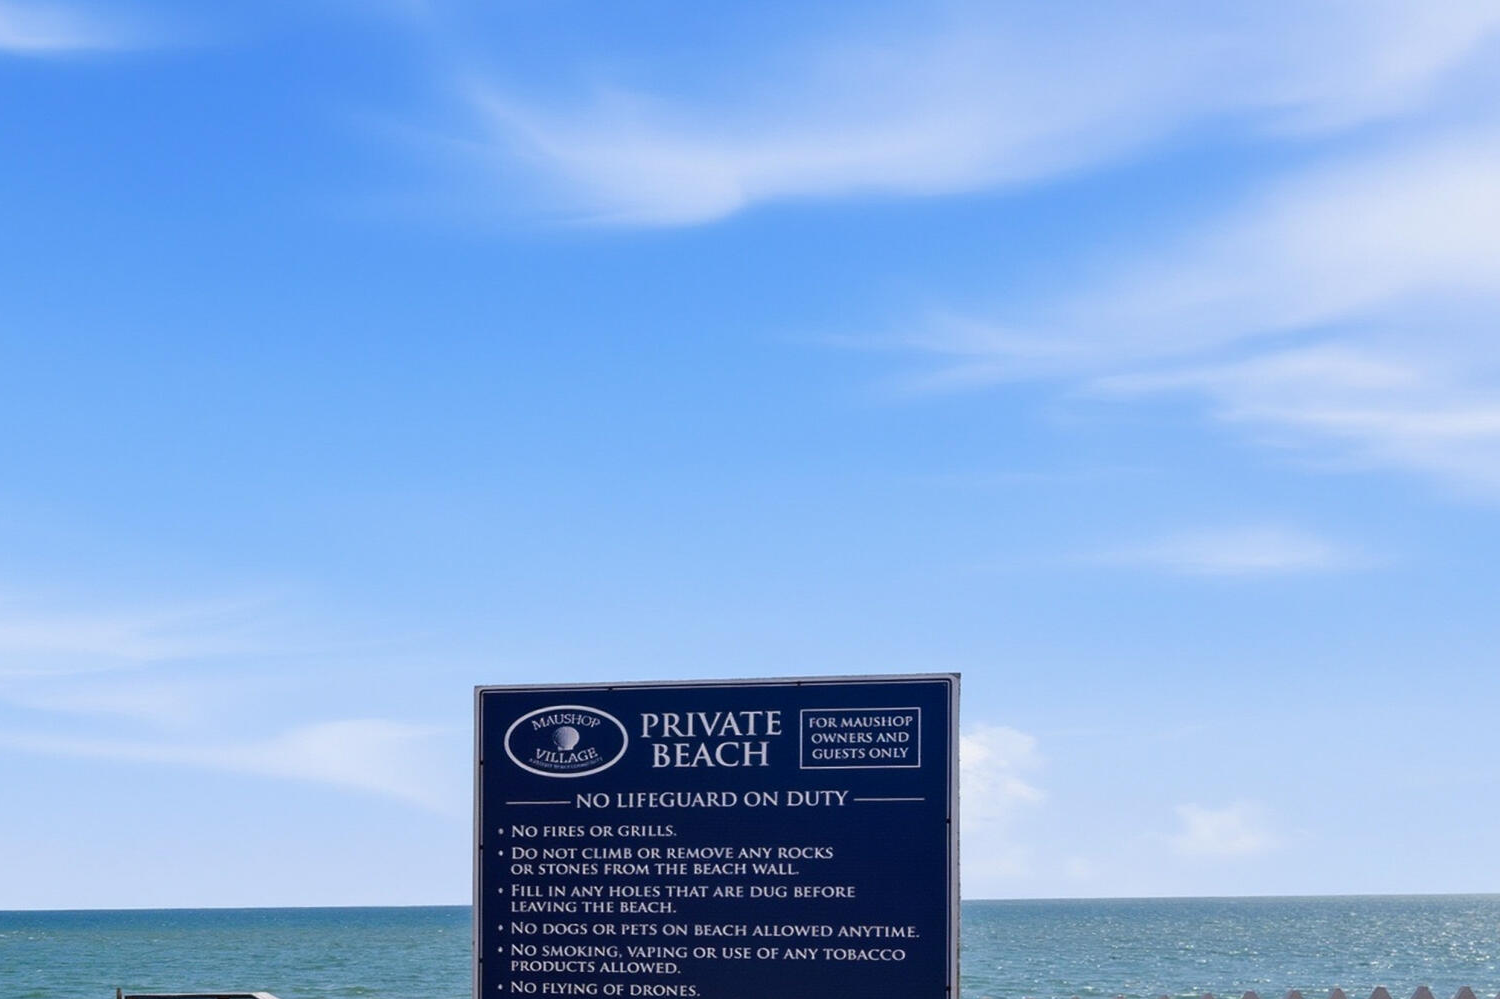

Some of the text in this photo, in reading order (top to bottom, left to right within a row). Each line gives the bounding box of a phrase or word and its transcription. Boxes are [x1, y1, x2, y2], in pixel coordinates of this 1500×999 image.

[531, 713, 602, 731] MAUSHOP
[640, 710, 782, 738] PRIVATE
[808, 715, 913, 729] FOR MAUSHOP
[810, 731, 910, 745] OWNERS AND
[535, 746, 599, 763] VILLAGE
[651, 741, 770, 768] BEACH
[811, 747, 909, 760] GUESTS ONLY
[576, 790, 849, 809] NO LIFEGUARD ON DUTY
[511, 824, 677, 838] NO FIRES OR GRILLS.
[511, 846, 834, 860] DO NOT CLIMB OR REMOVE ANY ROCKS
[510, 862, 800, 876] OR STONES FROM THE BEACH WALL.
[511, 883, 856, 898] FILL IN ANY HOLES THAT ARE DUG BEFORE
[511, 900, 677, 914] LEAVING THE BEACH.
[511, 921, 920, 938] NO DOGS OR PETS ON BEACH ALLOWED ANYTIME.
[511, 943, 906, 961] NO SMOKING, VAPING OR USE OF ANY TOBACCO
[511, 960, 681, 974] PRODUCTS ALLOWED.
[510, 980, 701, 997] NO FLYING OF DRONES.
